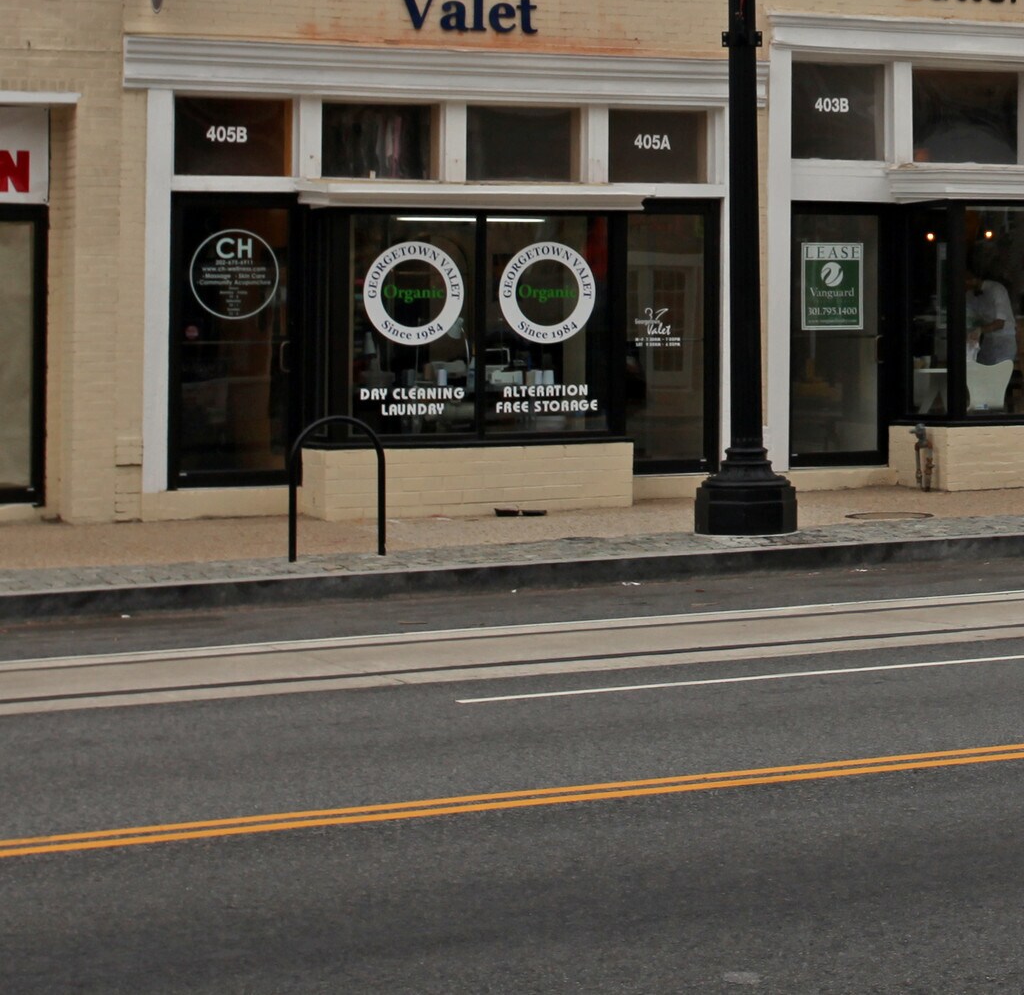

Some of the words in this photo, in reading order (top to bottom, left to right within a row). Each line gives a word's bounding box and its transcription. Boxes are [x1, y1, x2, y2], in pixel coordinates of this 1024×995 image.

[815, 97, 849, 112] 403B
[206, 126, 248, 143] 405B
[634, 134, 671, 150] 405A
[216, 237, 253, 259] CH
[805, 246, 860, 259] LEASE
[367, 245, 440, 299] GEORGETOWN
[440, 258, 460, 300] VALET
[503, 245, 572, 298] GEORGETOWN
[572, 258, 592, 299] VALET
[383, 284, 445, 304] Organic
[518, 284, 577, 303] Organic
[810, 286, 855, 300] Vanguard
[381, 320, 413, 340] Since
[416, 323, 444, 340] 1984
[518, 320, 548, 339] Since
[552, 321, 578, 339] 1984
[647, 320, 672, 336] Valet
[360, 388, 388, 400] DRY
[392, 387, 466, 400] CLEANING
[503, 384, 589, 398] ALTERATION
[381, 403, 445, 416] LAUNDRY
[496, 401, 529, 413] FREE
[534, 399, 598, 413] STORAGE
